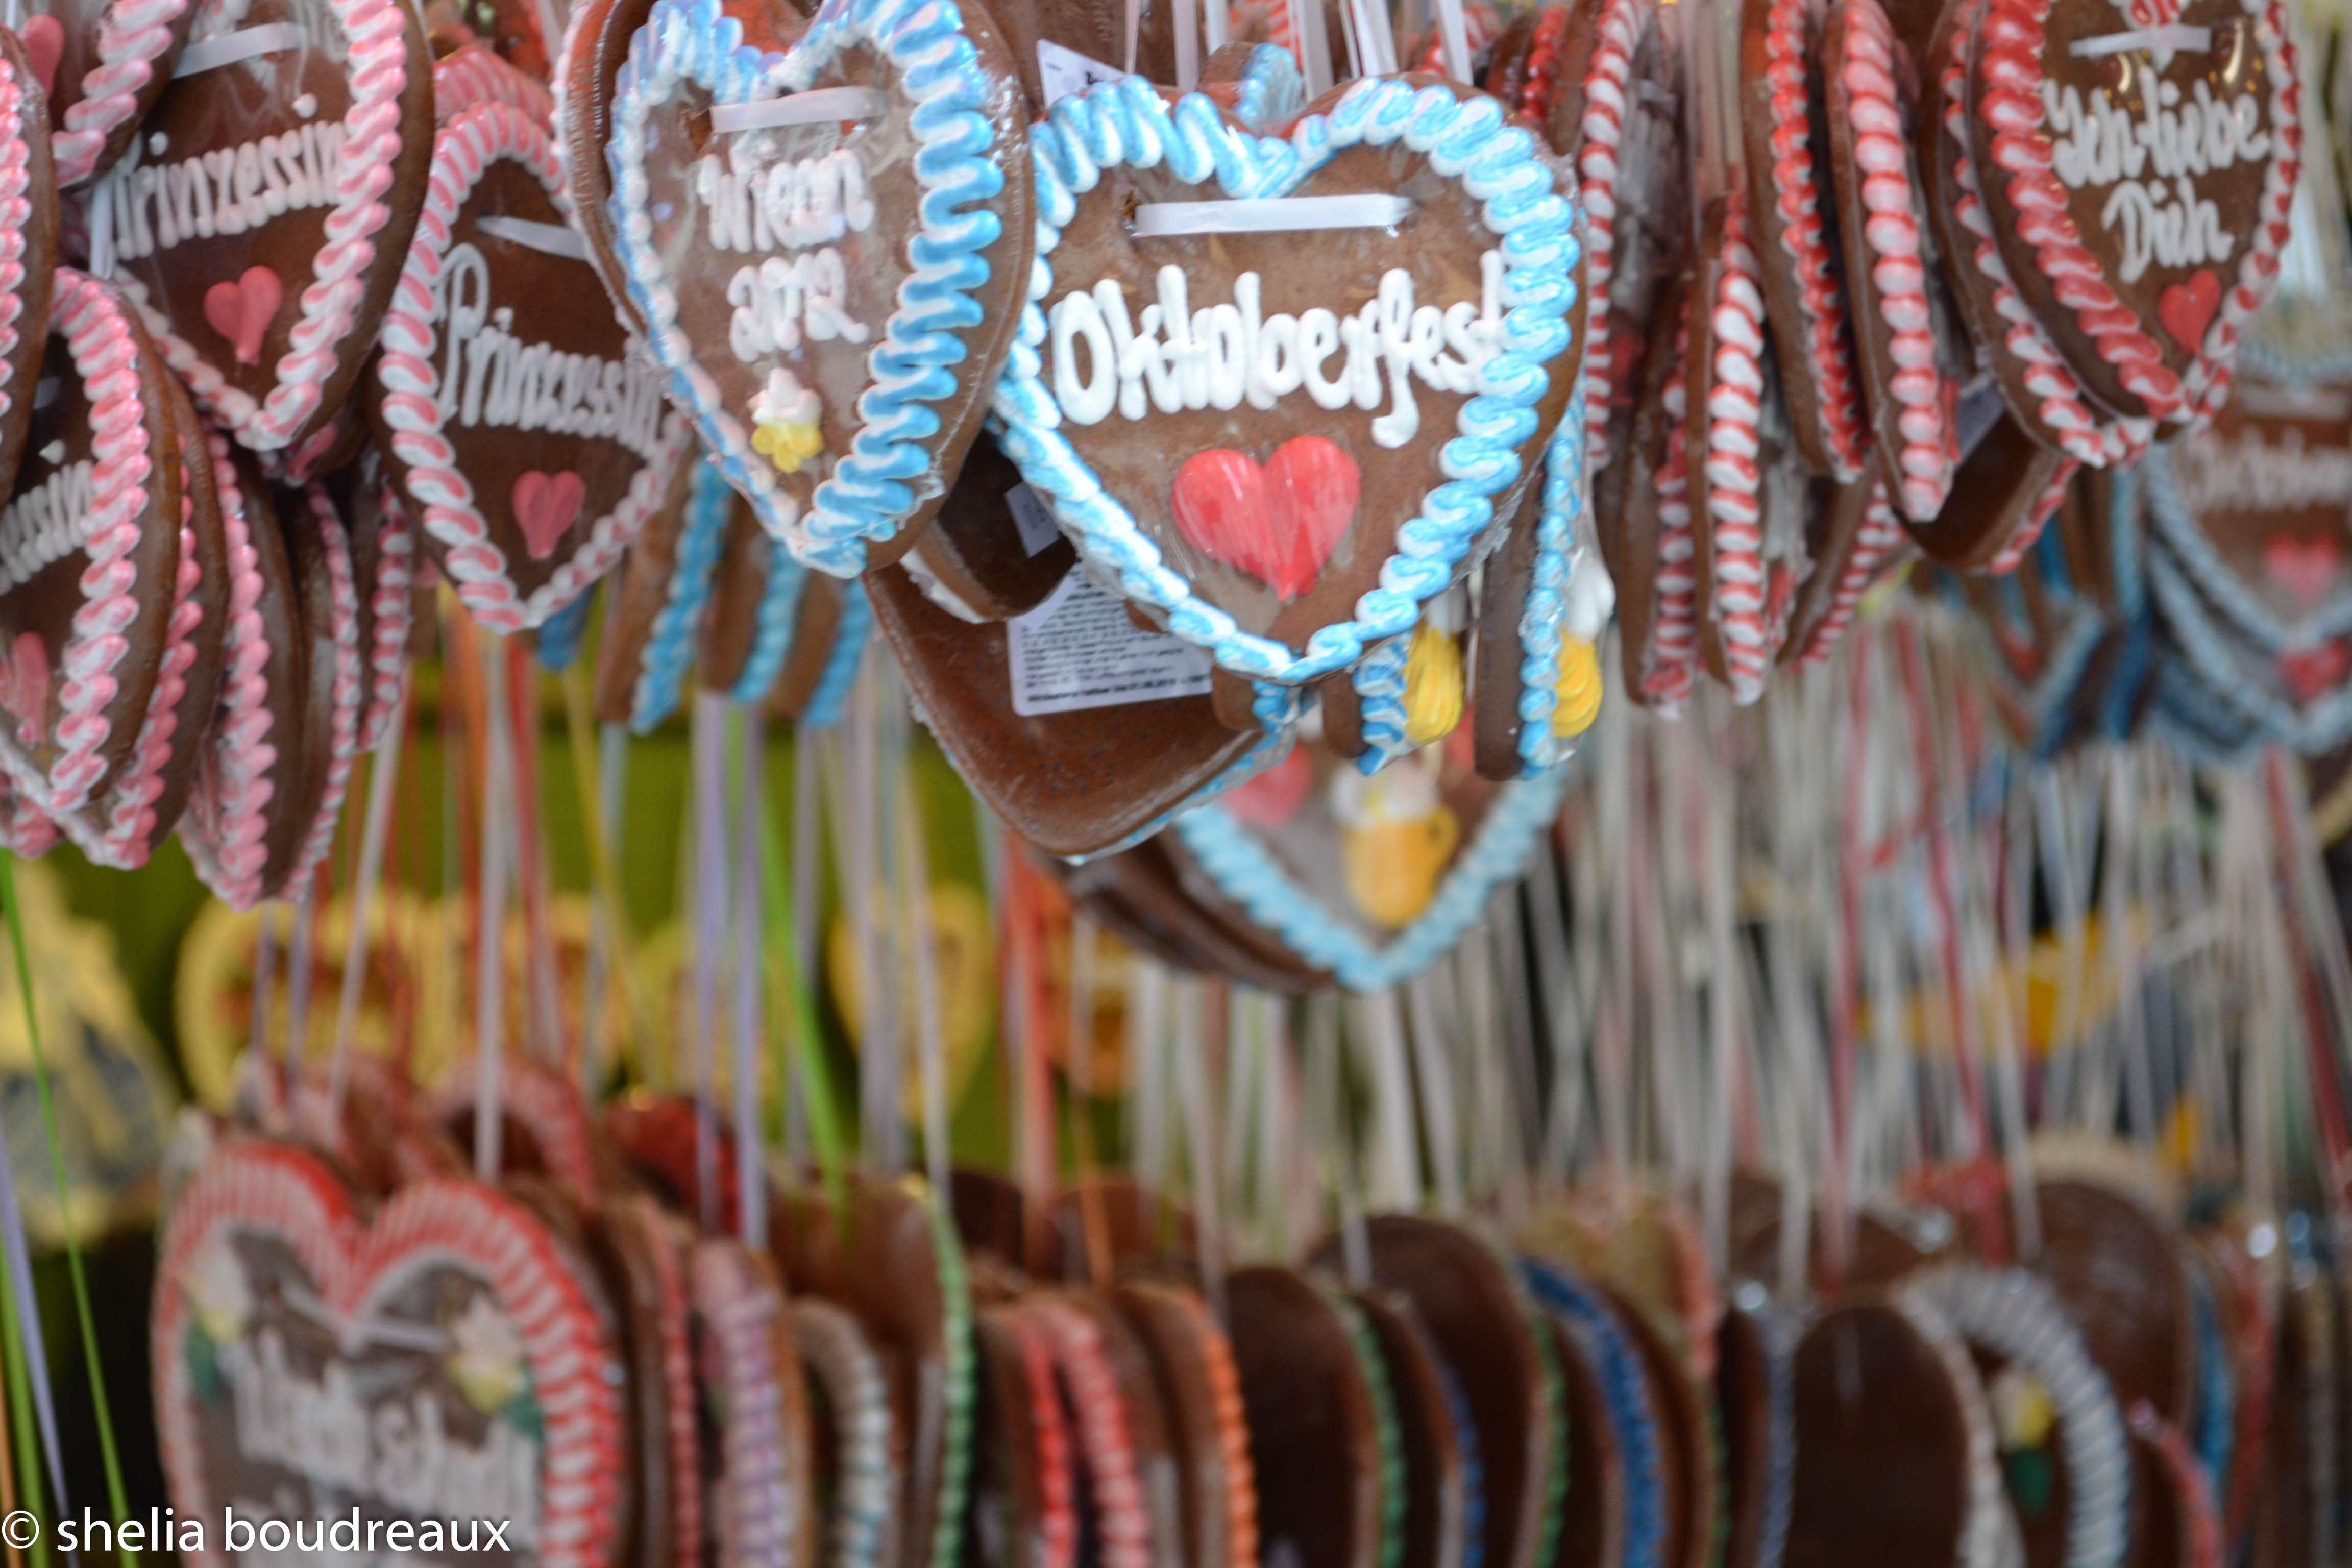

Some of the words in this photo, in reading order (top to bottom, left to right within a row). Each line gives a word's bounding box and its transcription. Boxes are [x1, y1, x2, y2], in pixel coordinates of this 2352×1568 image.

[2101, 179, 2235, 284] Dich
[436, 242, 663, 459] Prinzessin
[1049, 249, 1508, 449] Oktoberfest
